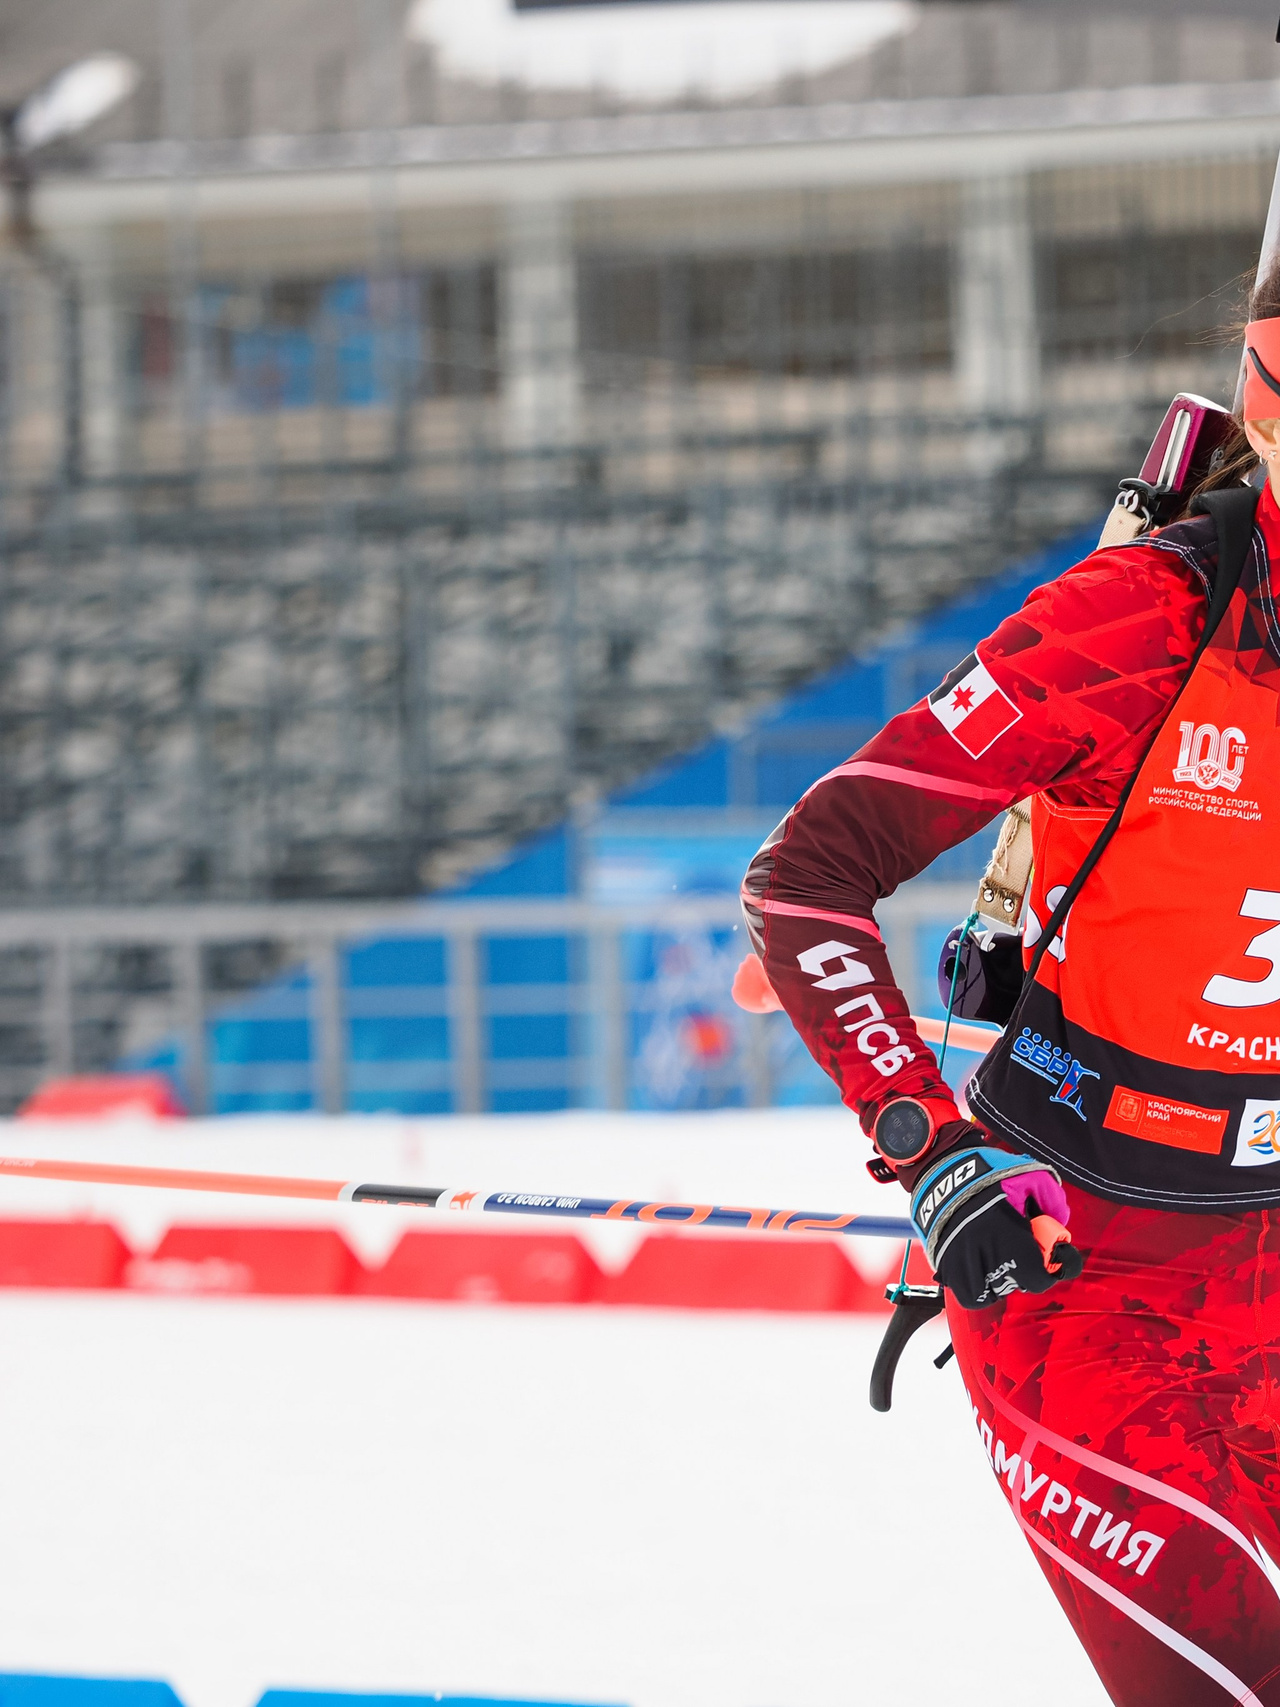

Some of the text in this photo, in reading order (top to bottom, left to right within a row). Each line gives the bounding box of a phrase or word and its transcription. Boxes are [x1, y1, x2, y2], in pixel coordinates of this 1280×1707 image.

[1177, 721, 1247, 778] 100
[1231, 744, 1250, 755] ЛЕТ
[1148, 796, 1262, 821] РОССИЙСКОЙ ФЕДЕРАЦИИ
[1153, 786, 1259, 810] МИНИСТЕРСТВО СПОРТА
[833, 992, 916, 1077] ПСБ
[1013, 1035, 1069, 1076] СБР
[1146, 1109, 1170, 1122] КРАЙ
[1147, 1100, 1222, 1123] КРАСНОЯРСКИЙ
[513, 1194, 556, 1208] CARBON
[919, 1159, 977, 1229] KV+
[590, 1200, 861, 1236] PILOT
[972, 1405, 1166, 1576] ДМУРТИЯ
